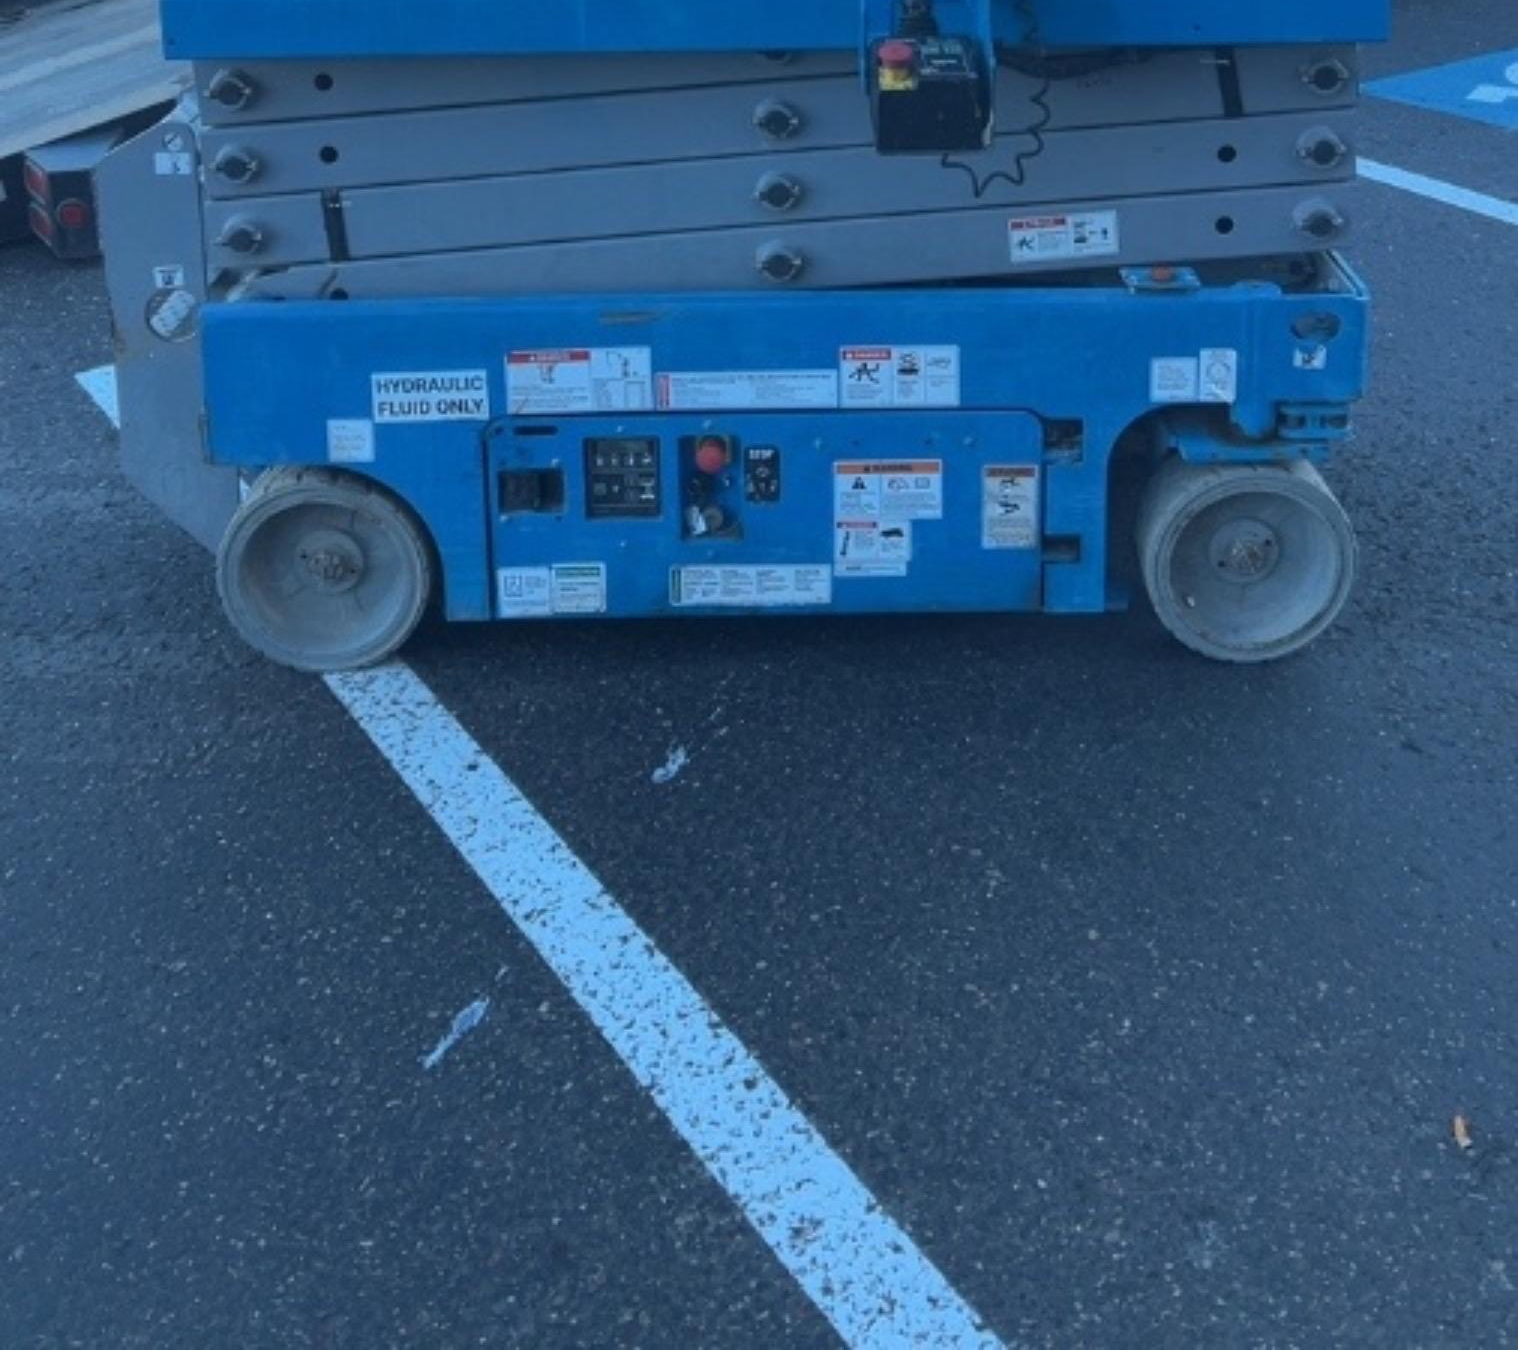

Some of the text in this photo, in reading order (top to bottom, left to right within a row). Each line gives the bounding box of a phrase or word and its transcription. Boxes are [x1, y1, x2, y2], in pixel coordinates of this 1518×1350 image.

[377, 375, 484, 394] HYDRAULIC
[378, 398, 484, 417] FLUID ONLY
